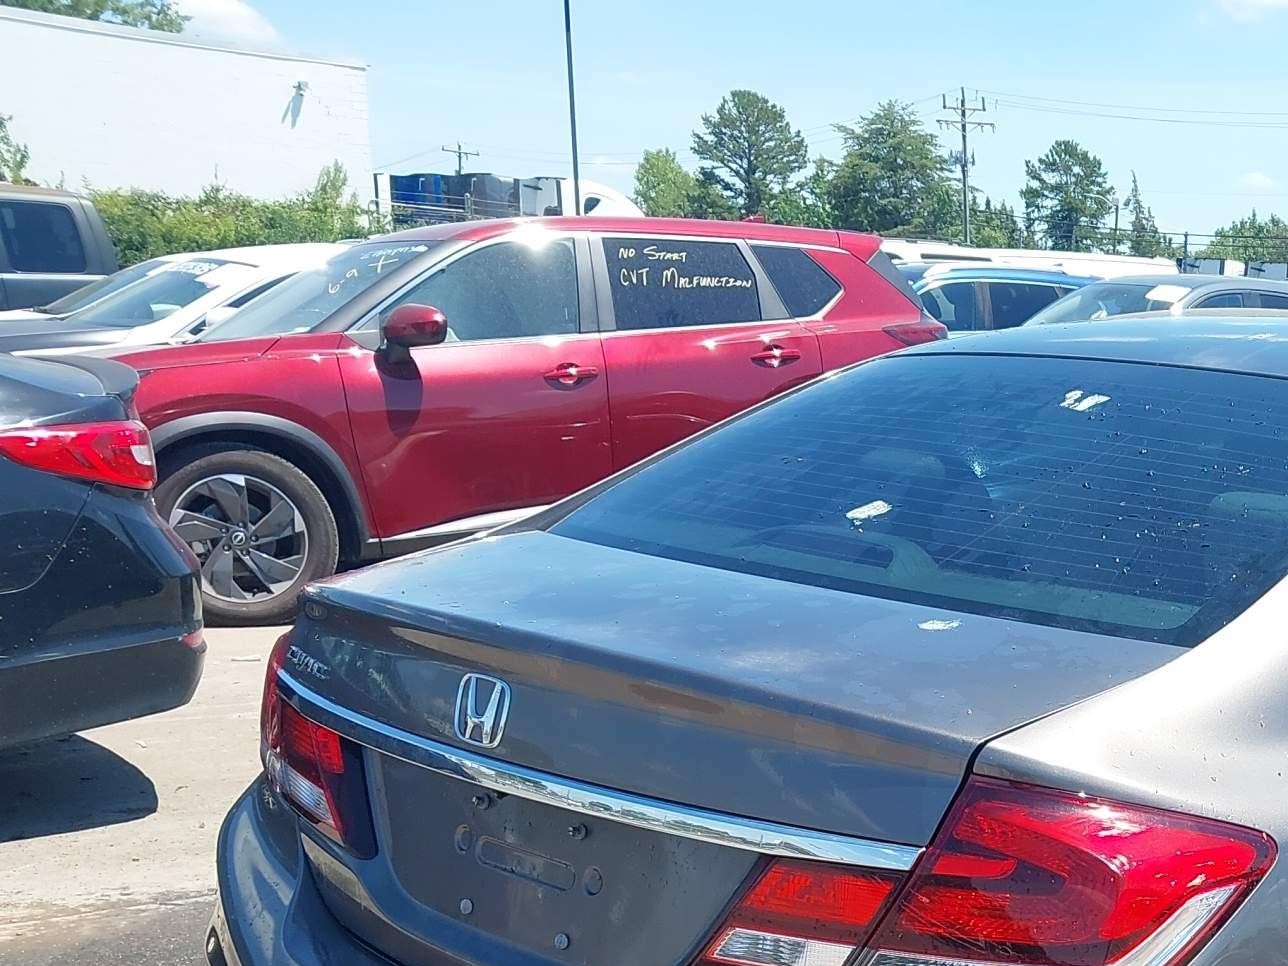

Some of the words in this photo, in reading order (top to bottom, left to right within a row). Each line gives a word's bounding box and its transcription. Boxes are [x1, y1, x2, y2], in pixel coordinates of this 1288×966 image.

[618, 247, 636, 259] NO
[643, 246, 687, 262] START
[620, 268, 649, 286] CVT
[662, 267, 752, 288] MALFUNCTION
